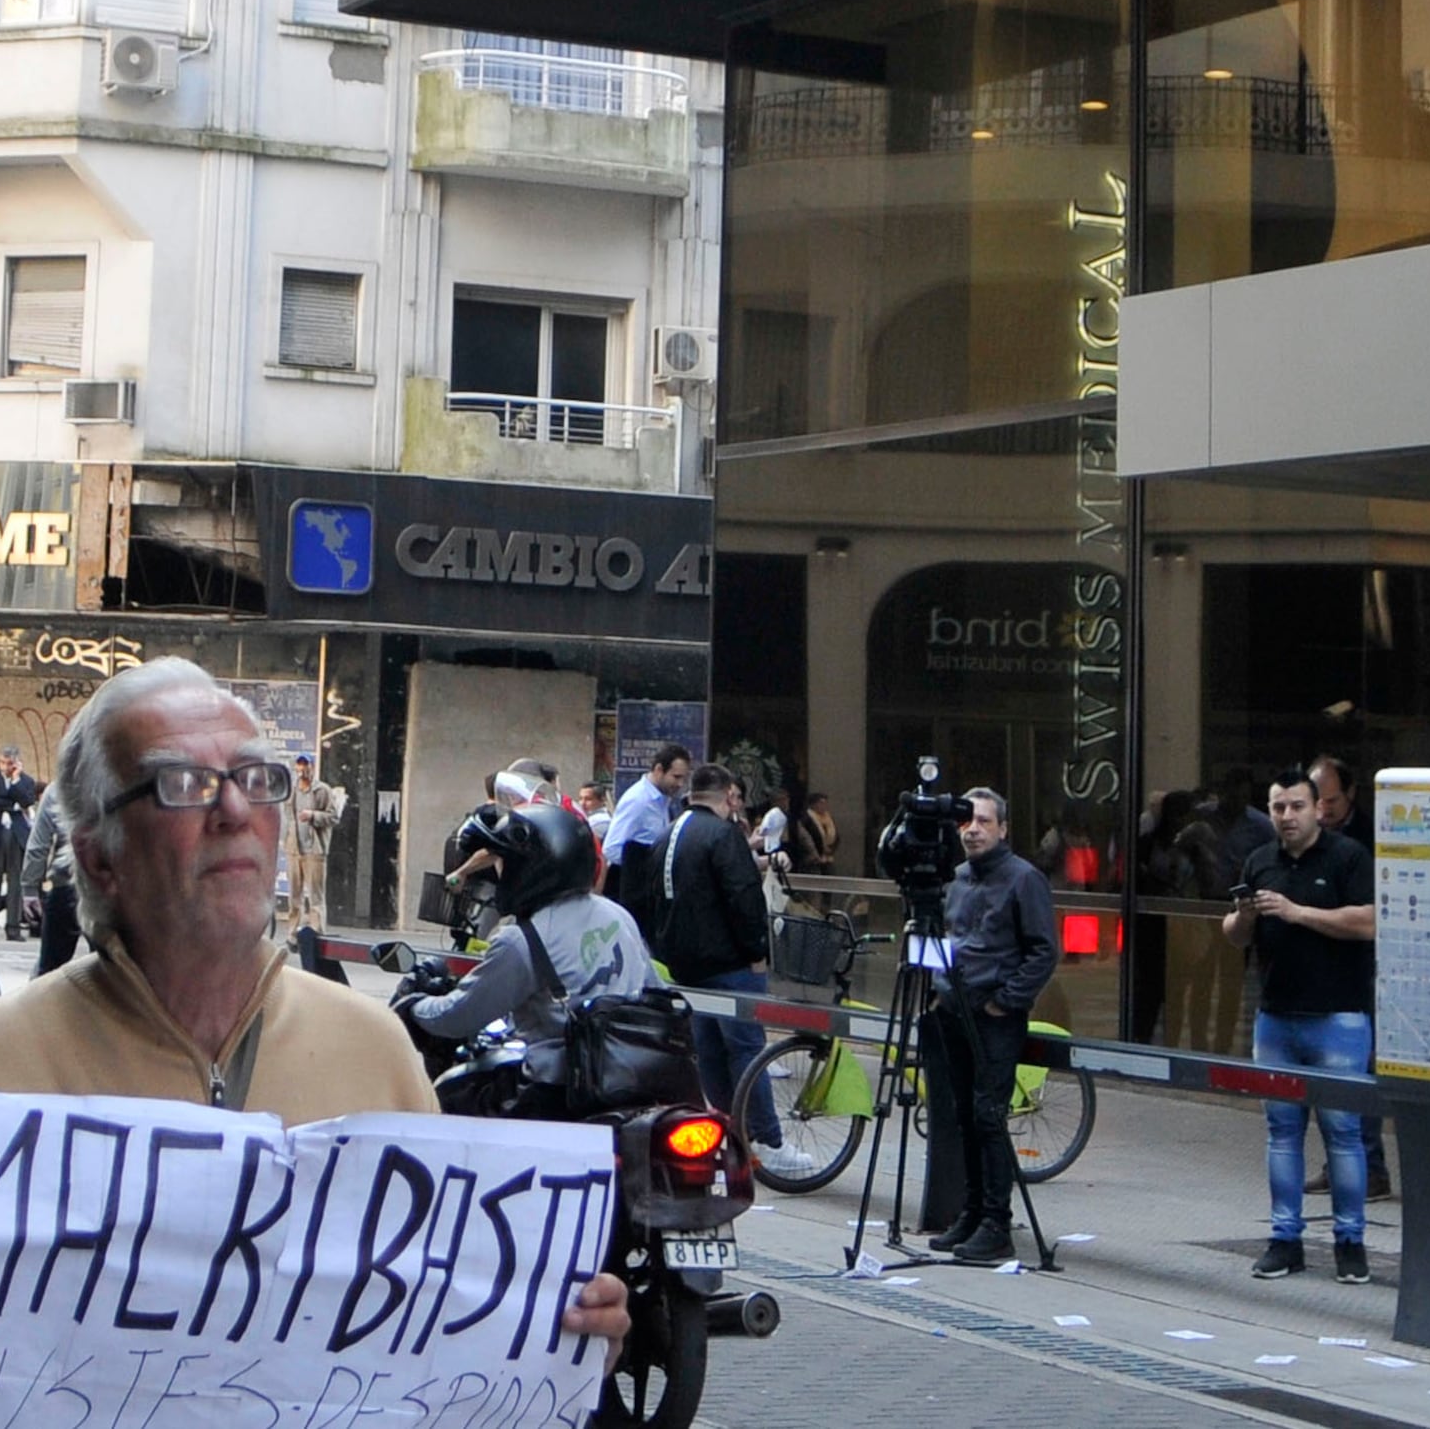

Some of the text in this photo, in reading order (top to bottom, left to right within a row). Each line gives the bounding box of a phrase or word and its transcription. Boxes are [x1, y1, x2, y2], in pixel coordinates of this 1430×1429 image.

[395, 522, 713, 596] CAMBIO A
[1062, 571, 1122, 804] SWISS
[675, 1242, 729, 1265] 8TFP
